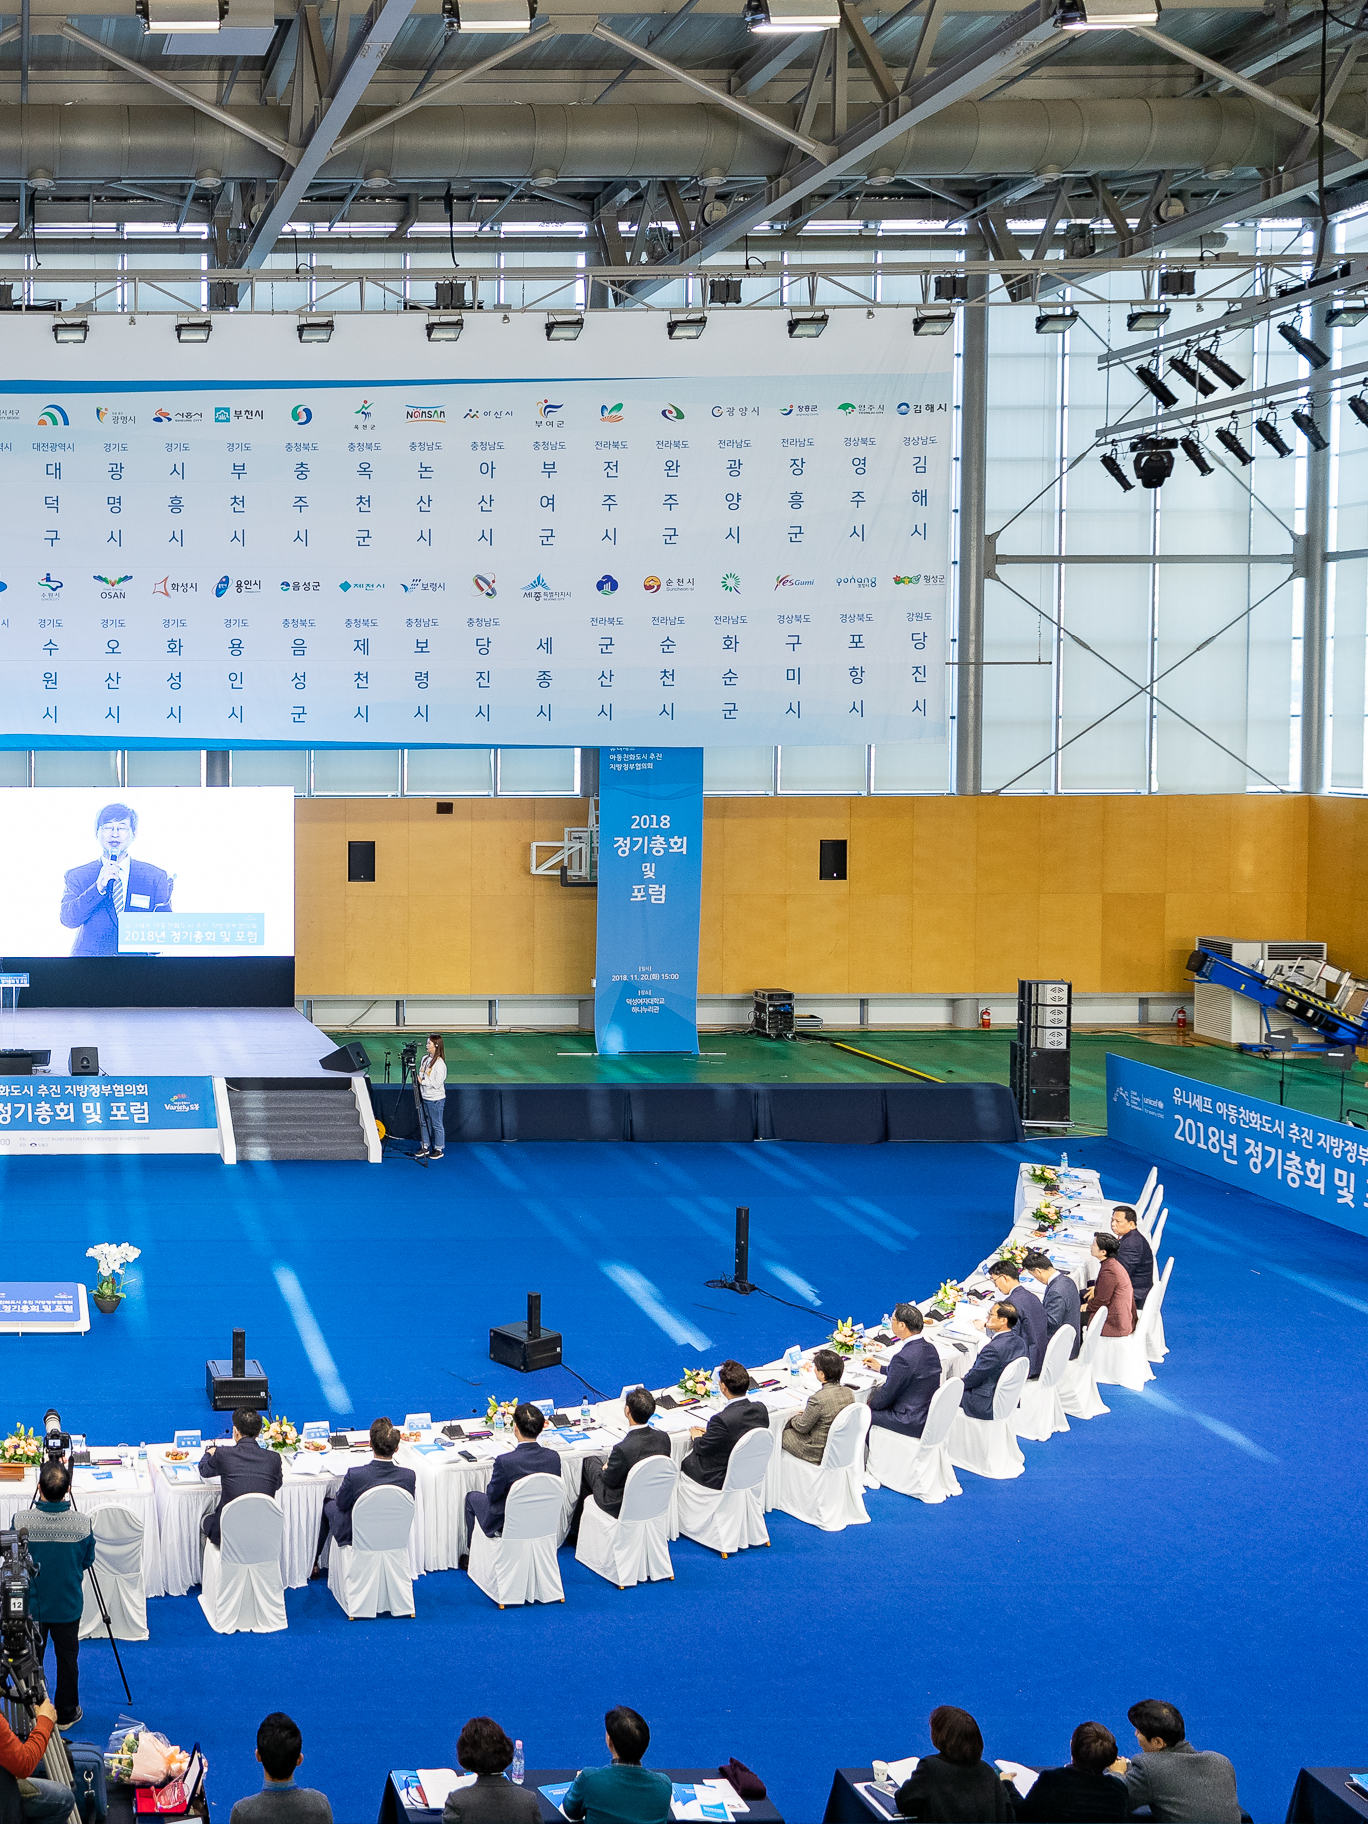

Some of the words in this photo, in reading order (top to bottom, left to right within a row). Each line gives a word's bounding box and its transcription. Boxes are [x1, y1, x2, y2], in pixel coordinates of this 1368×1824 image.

[726, 407, 759, 416] 광양시
[914, 403, 946, 413] 김해시
[112, 413, 135, 424] 광명시
[234, 410, 263, 419] 부천시
[533, 441, 566, 450] 충청남도
[595, 441, 628, 450] 전라북도
[781, 438, 814, 447] 전라남도
[844, 437, 876, 446] 경상북도
[903, 436, 937, 446] 경상남도
[33, 443, 74, 452] 대전광역시
[165, 443, 190, 452] 경기도
[227, 443, 251, 452] 경기도
[285, 443, 319, 452] 충청북도
[409, 442, 442, 451] 충청남도
[235, 580, 261, 590] 용인시
[666, 578, 694, 586] 순천시
[924, 575, 945, 585] 횡성군
[171, 583, 197, 593] 화성시
[292, 582, 320, 591] 음성군
[421, 582, 445, 592] 보령시
[777, 615, 811, 624] 경상북도
[907, 612, 932, 622] 강원도
[163, 619, 187, 628] 경기도
[631, 815, 670, 829] 2018
[614, 835, 687, 857] 정기총회
[642, 863, 655, 879] 및
[630, 884, 666, 903] 포럼
[125, 931, 166, 943] 2018년
[171, 931, 216, 943] 정기총회
[220, 931, 231, 942] 및
[235, 931, 257, 943] 포럼
[37, 1084, 61, 1097] 추진
[65, 1082, 148, 1098] 지방정부협의회
[82, 1102, 103, 1123] 및
[109, 1102, 149, 1123] 포럼
[1173, 1087, 1213, 1115] 유니세프
[1216, 1101, 1285, 1140] 아동친화도시
[1289, 1122, 1313, 1149] 추진
[1174, 1114, 1237, 1165] 2018년
[1244, 1137, 1325, 1195] 정기총회
[1334, 1171, 1355, 1208] 및
[55, 1305, 73, 1313] 포럼
